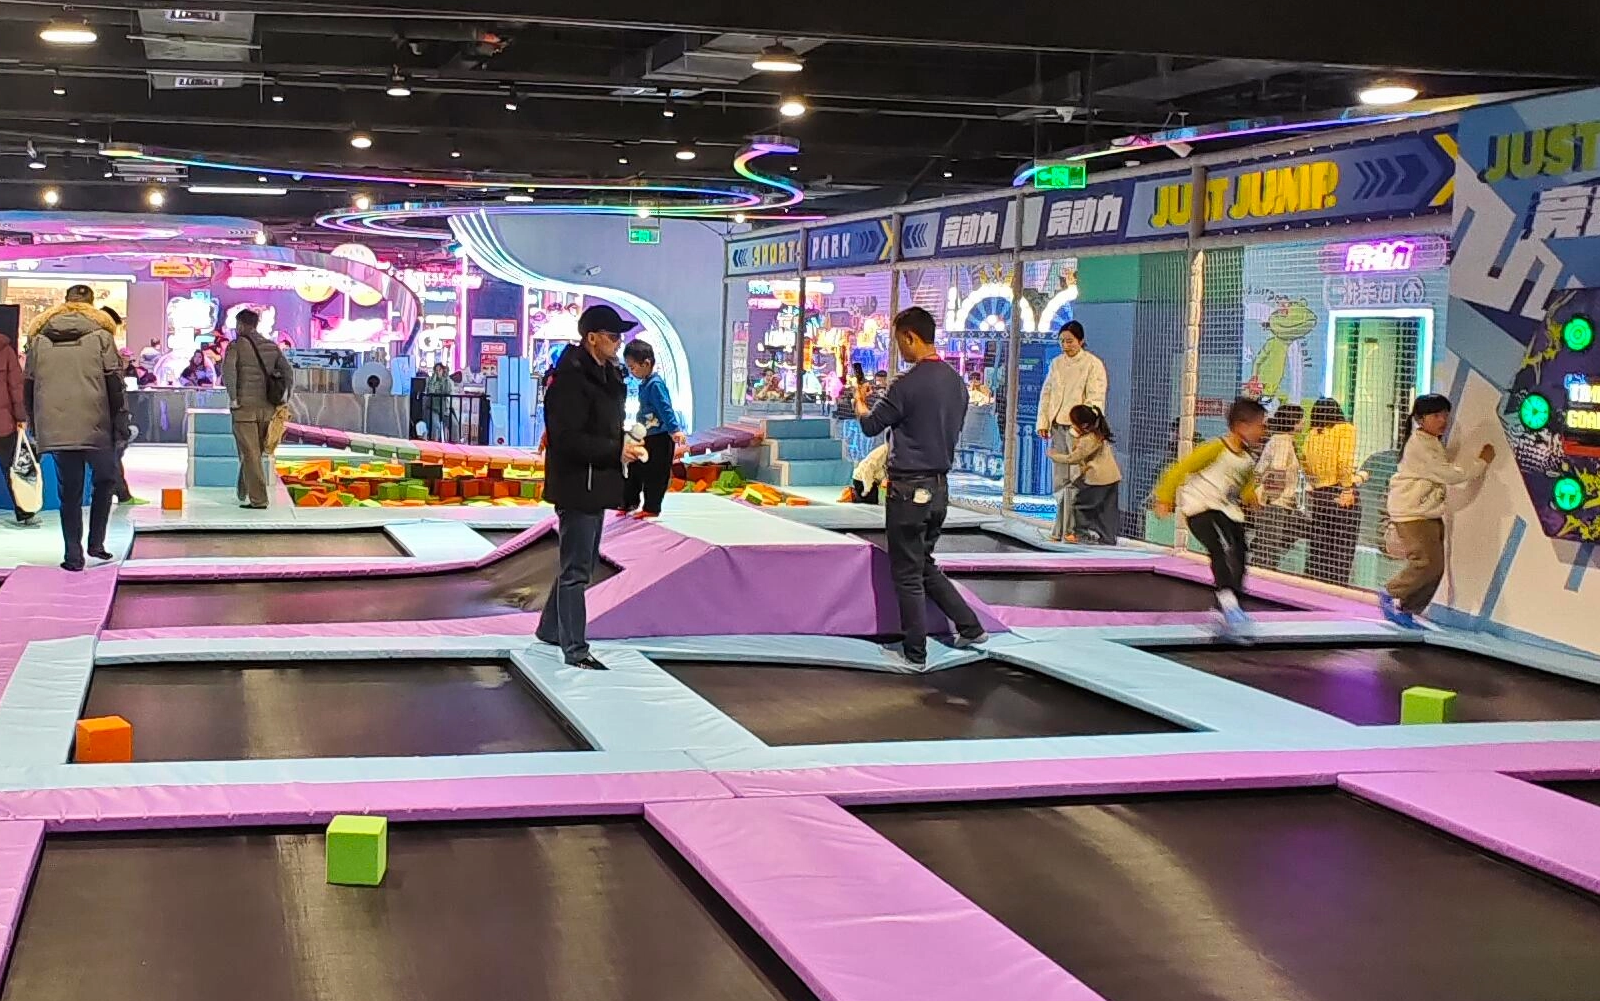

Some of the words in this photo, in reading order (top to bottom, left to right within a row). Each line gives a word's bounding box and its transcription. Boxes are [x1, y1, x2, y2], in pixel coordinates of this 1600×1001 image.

[1484, 120, 1600, 183] JUST
[1150, 177, 1229, 229] JUT
[811, 232, 851, 261] PARK
